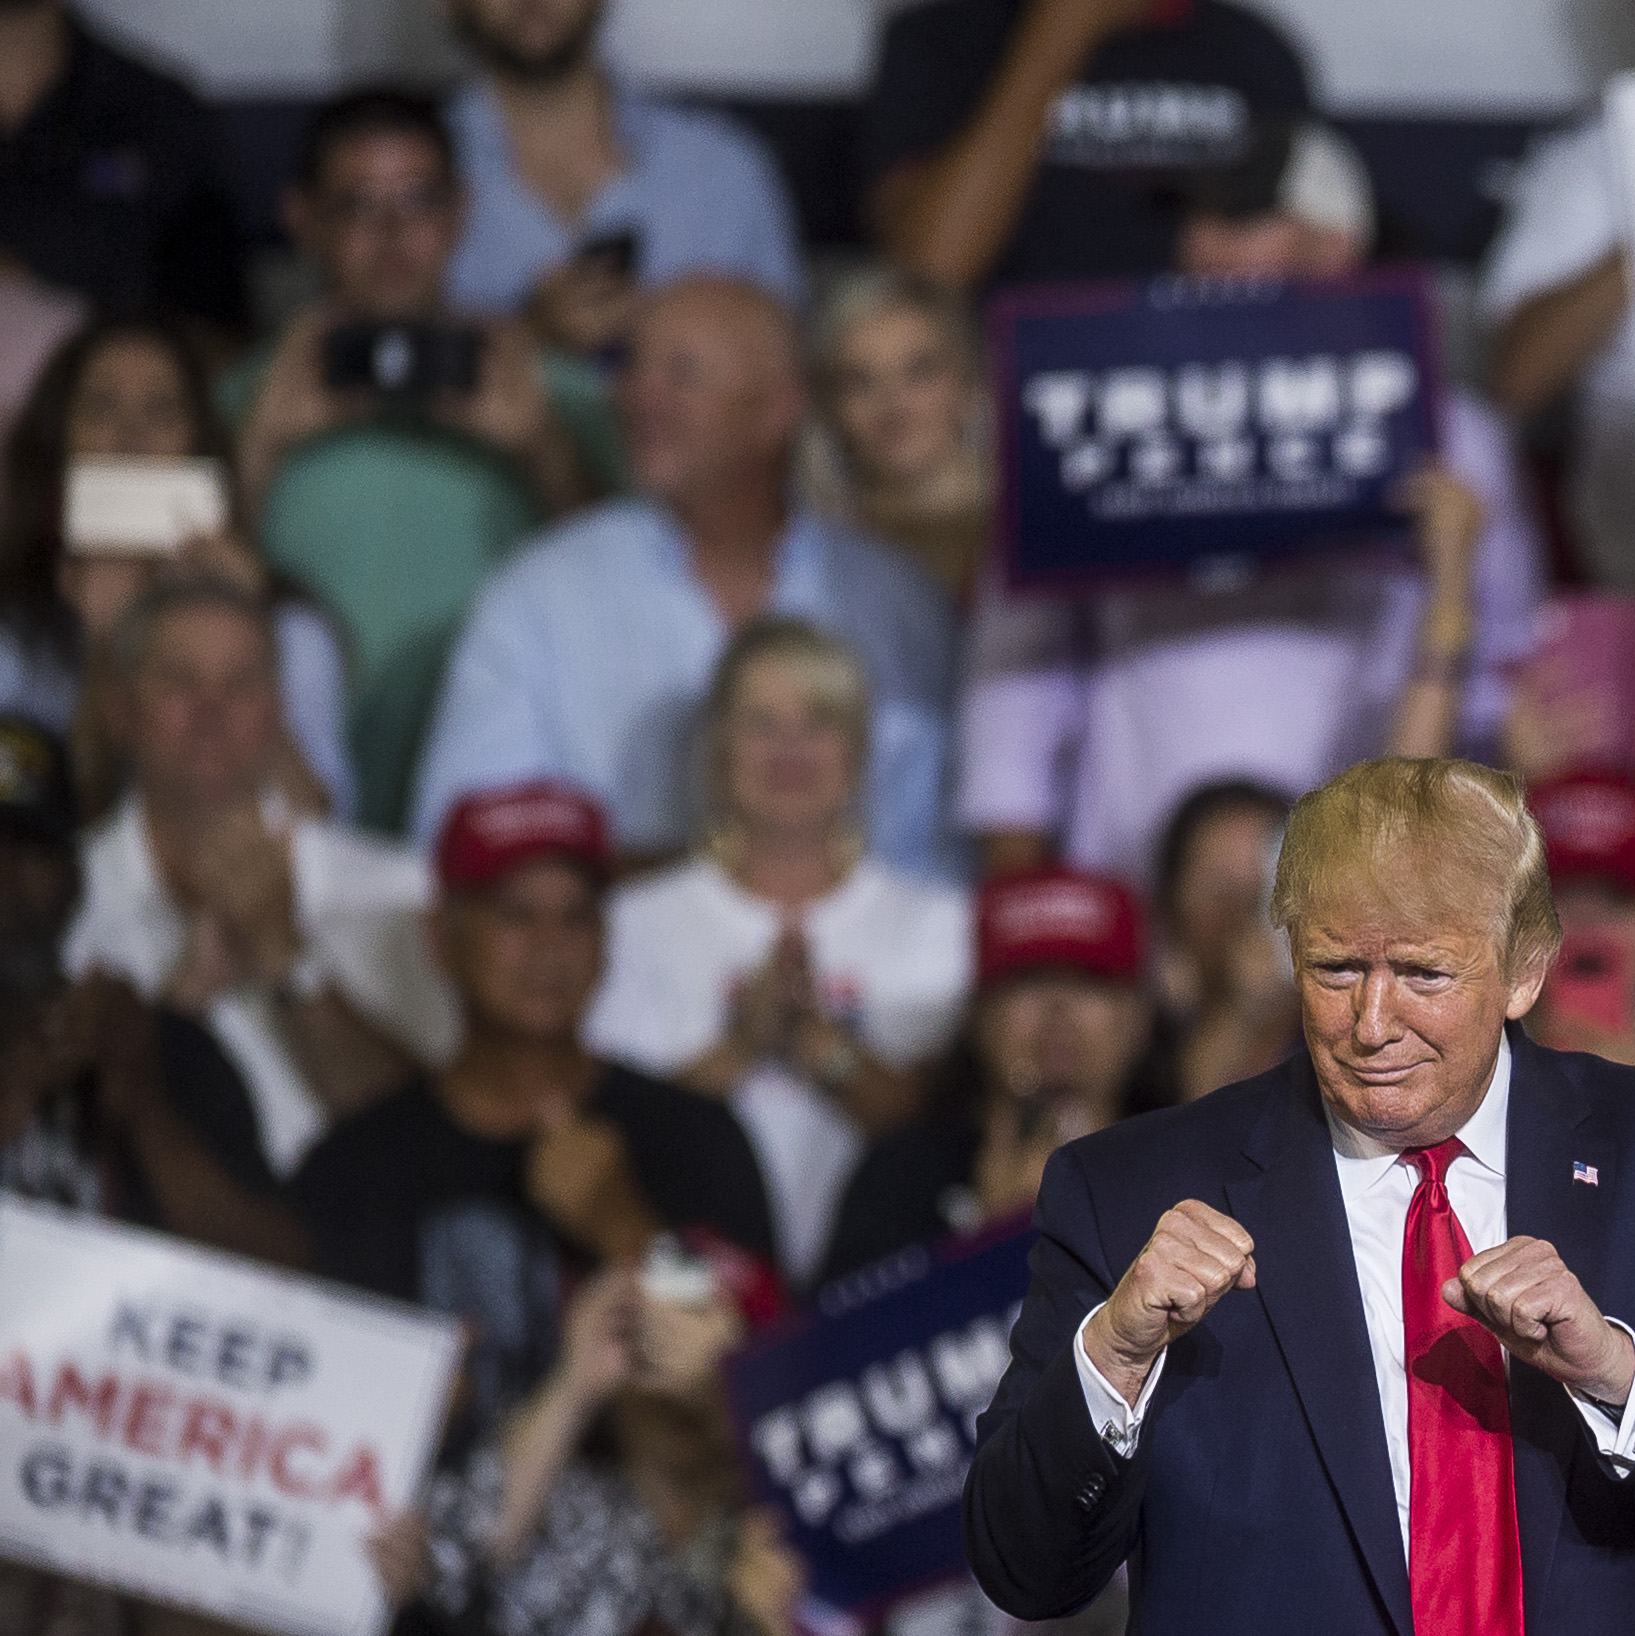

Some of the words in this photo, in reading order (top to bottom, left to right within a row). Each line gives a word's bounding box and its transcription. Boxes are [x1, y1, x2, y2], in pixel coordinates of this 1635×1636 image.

[1022, 350, 1418, 448] TRUMP
[105, 1300, 320, 1392] KEEP
[748, 1300, 1023, 1490] TRUM
[18, 1440, 315, 1585] GREAT!
